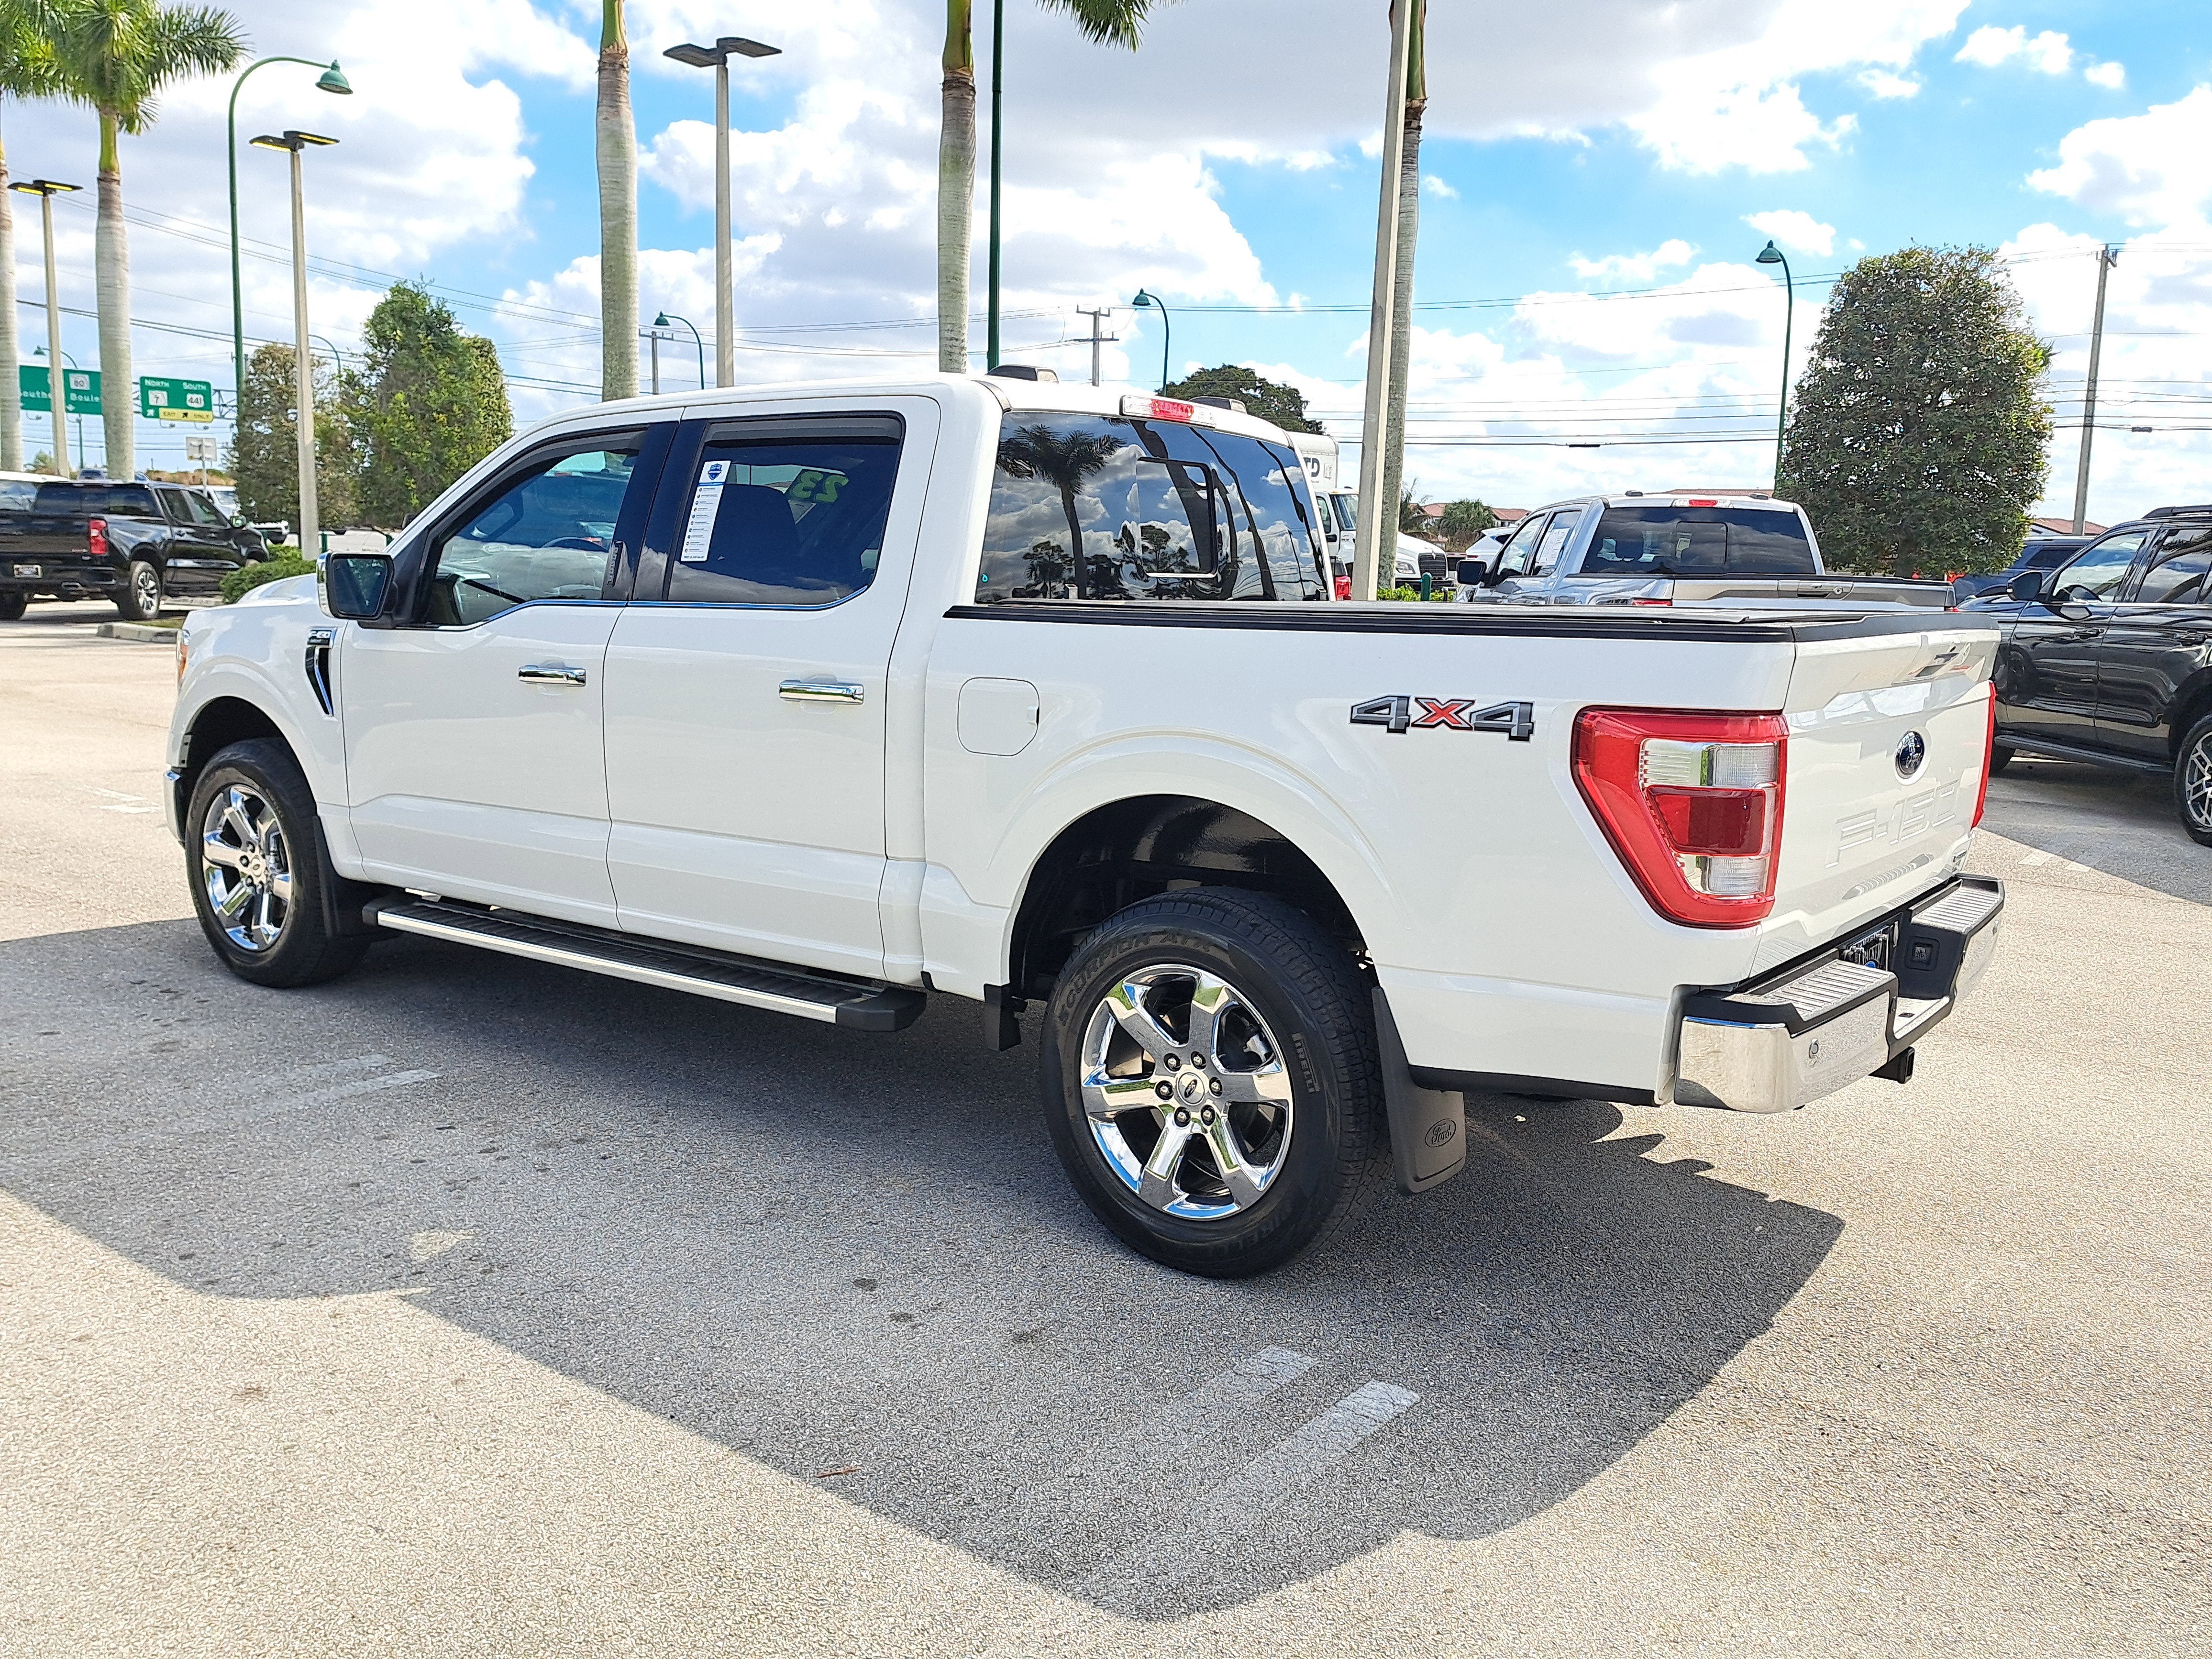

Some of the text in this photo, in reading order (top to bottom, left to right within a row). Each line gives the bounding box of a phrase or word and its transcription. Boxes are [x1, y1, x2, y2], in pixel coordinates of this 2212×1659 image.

[144, 378, 169, 387] NORTH
[182, 382, 207, 390] SOUTH
[154, 395, 159, 404] 7
[188, 397, 202, 405] 441
[1292, 1032, 1320, 1094] PIRELLI
[1431, 1122, 1452, 1145] Ford
